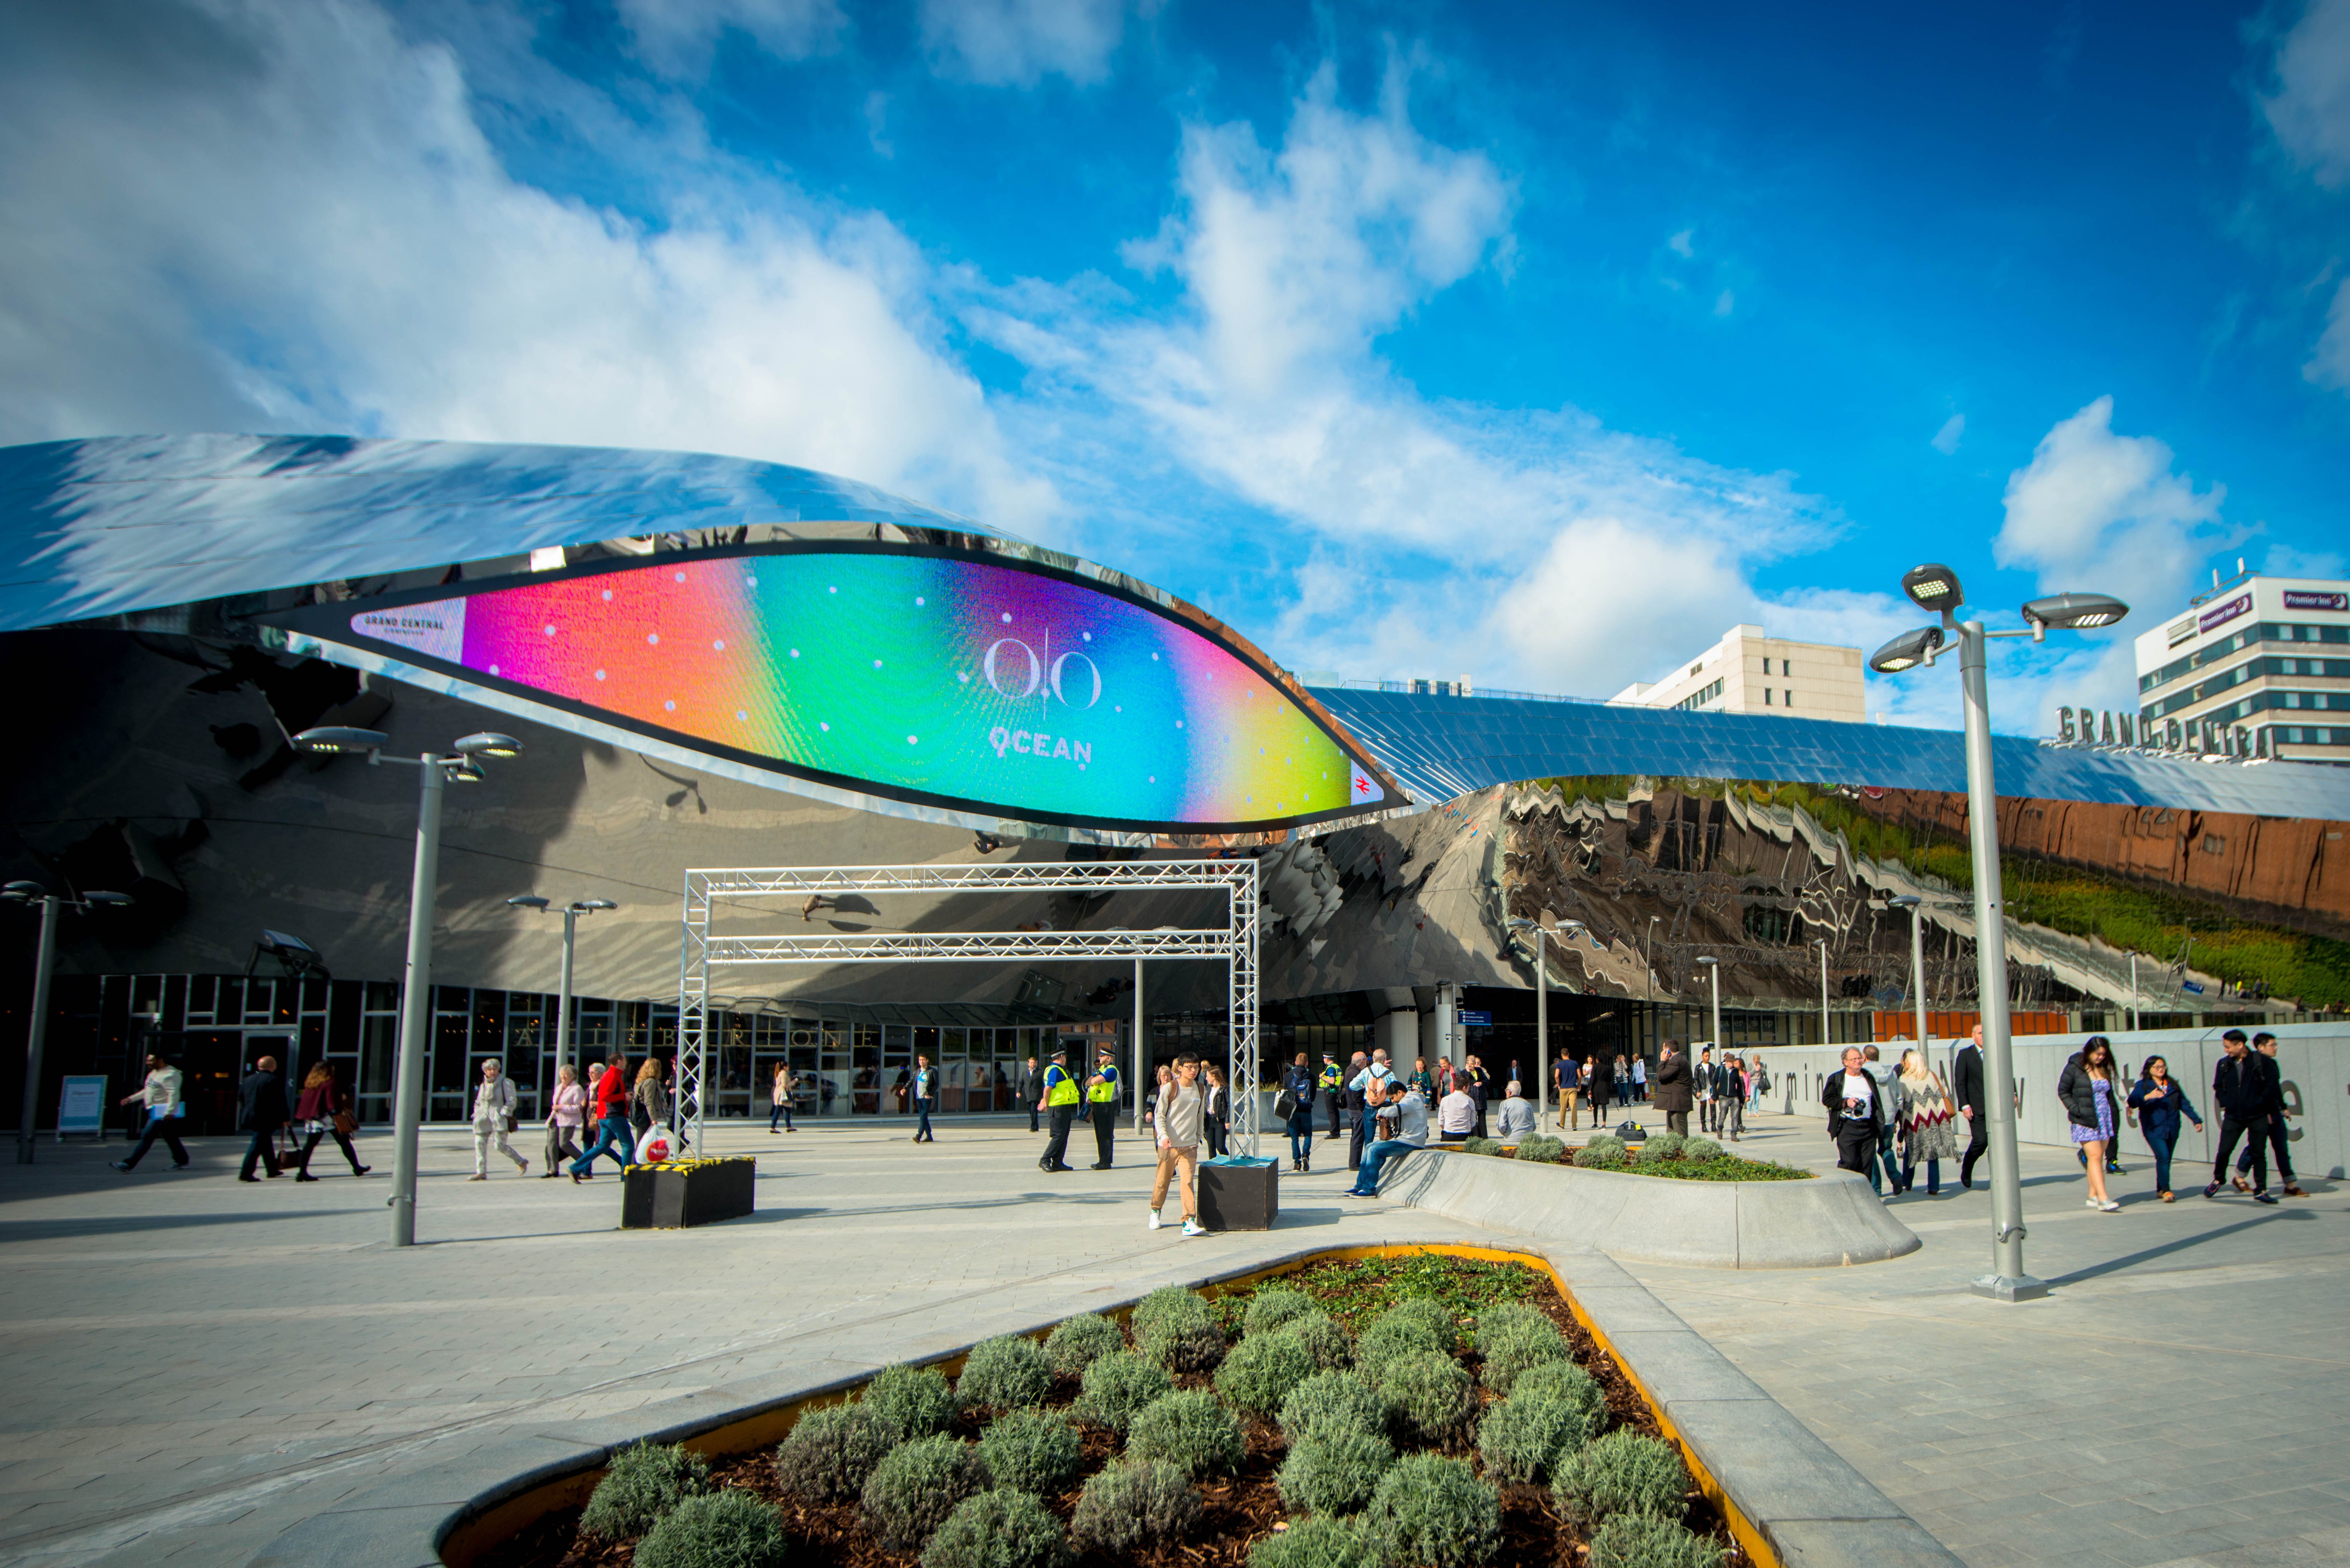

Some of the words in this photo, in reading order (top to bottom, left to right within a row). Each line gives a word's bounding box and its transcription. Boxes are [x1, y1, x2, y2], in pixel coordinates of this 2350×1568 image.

[2287, 594, 2318, 605] Premier
[2319, 595, 2332, 605] Inn
[365, 616, 397, 626] GRAND
[401, 618, 444, 630] CENTRAL
[2201, 610, 2226, 628] Premier
[2226, 606, 2237, 616] Inn
[2056, 705, 2152, 746] GRAND
[2161, 717, 2283, 760] CENTRAL
